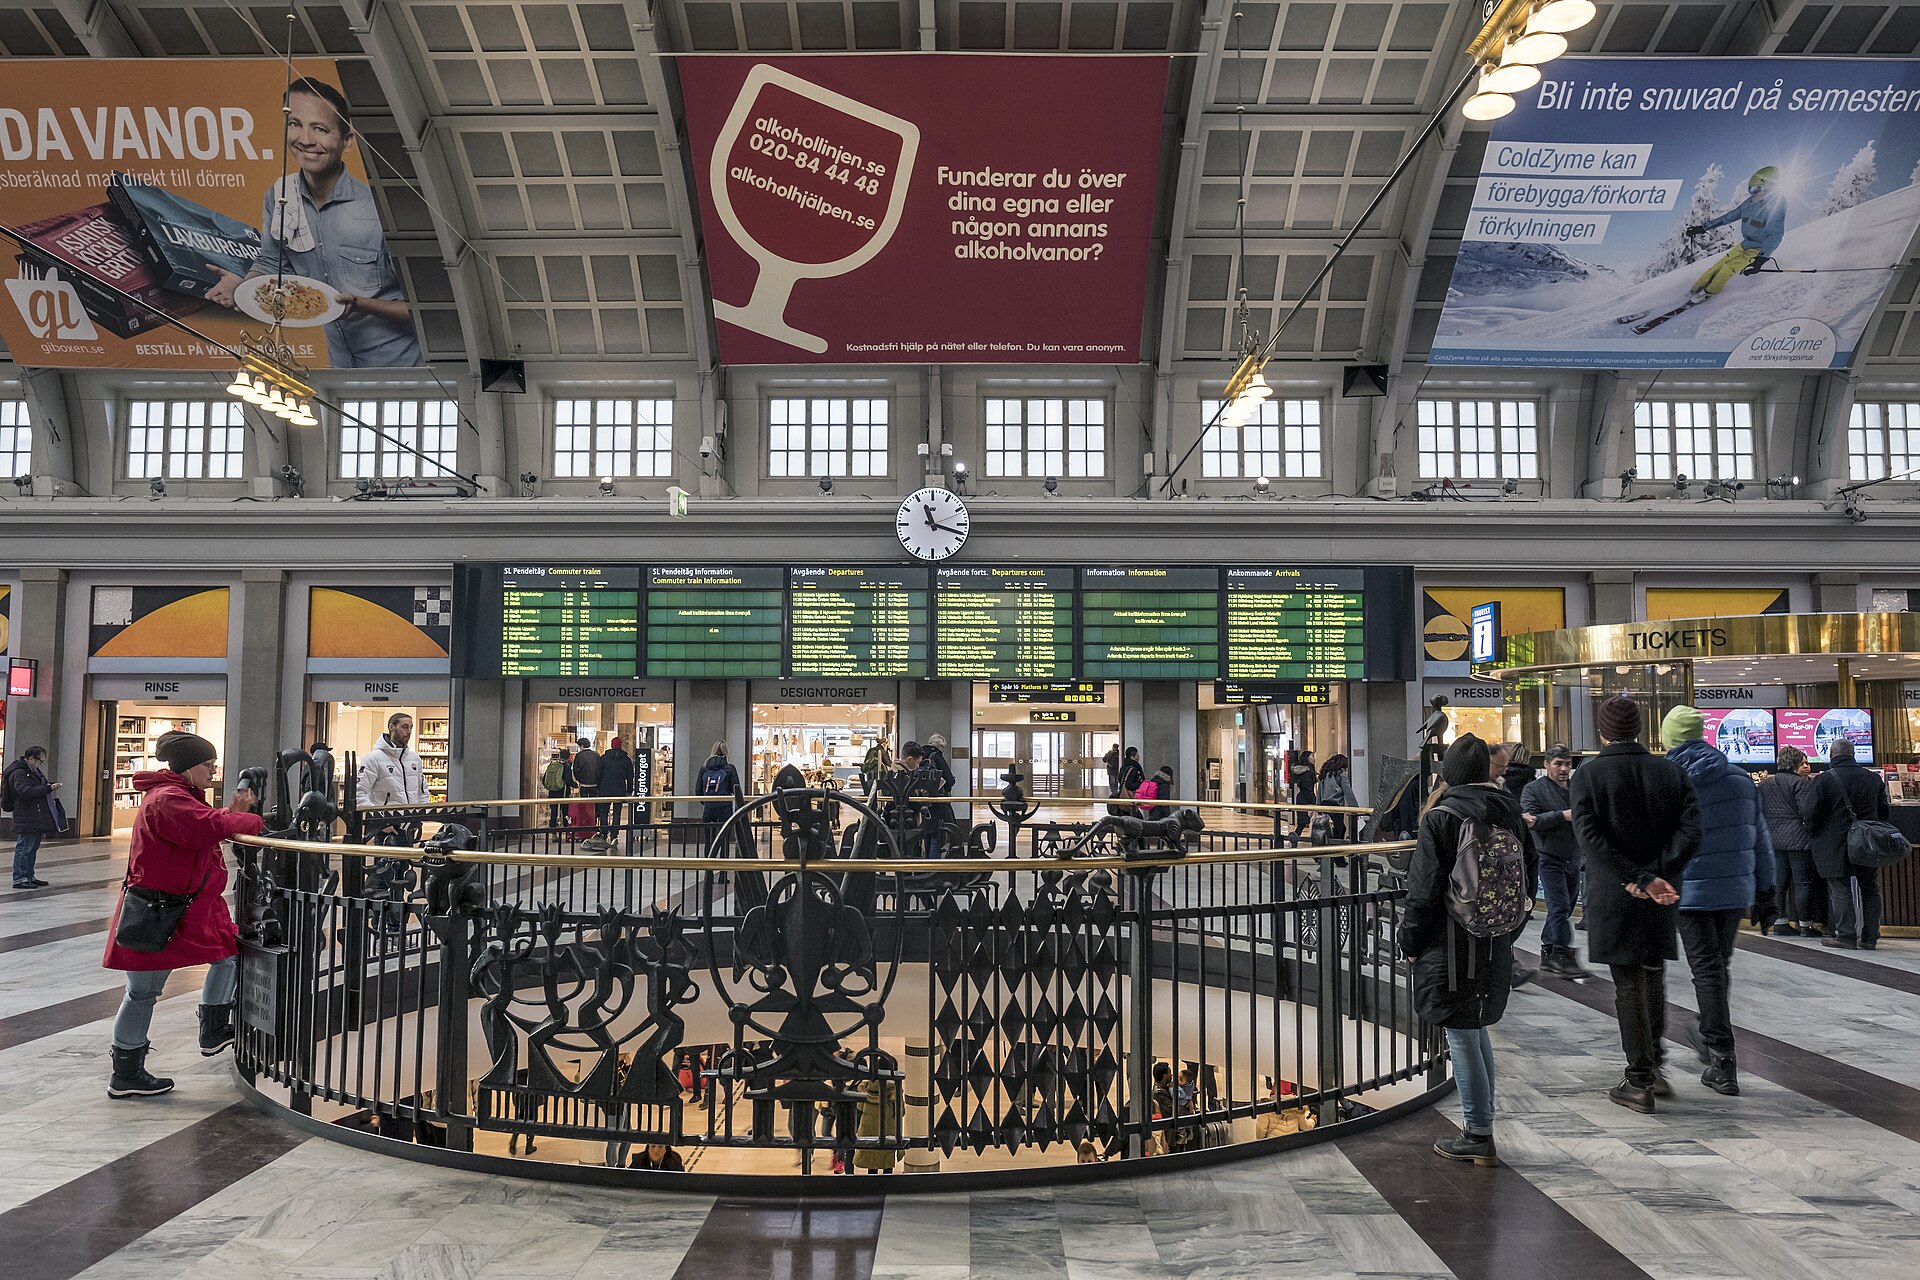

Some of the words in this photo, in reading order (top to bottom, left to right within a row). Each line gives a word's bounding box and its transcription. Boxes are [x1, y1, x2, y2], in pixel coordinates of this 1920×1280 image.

[1537, 80, 1574, 110] Bli
[1581, 81, 1633, 111] inte
[1640, 80, 1743, 112] snuvad
[1743, 78, 1785, 116] på
[0, 107, 74, 161] DA
[70, 106, 274, 161] VANOR.
[754, 116, 886, 178] alkohollinjen.se
[749, 133, 820, 174] 020-84
[824, 164, 850, 185] 44
[854, 175, 880, 196] 48
[1497, 146, 1595, 172] ColdZyme
[1600, 149, 1637, 170] kan
[0, 169, 82, 189] sberäknad
[86, 172, 119, 187] mat
[122, 169, 167, 188] direkt
[170, 168, 192, 188] till
[196, 168, 246, 188] dörren
[937, 166, 1037, 188] Funderar
[1042, 167, 1072, 188] du
[1078, 168, 1127, 189] över
[730, 166, 876, 230] alkoholhjälpen.se
[1487, 181, 1667, 209] förebygga/förkorta
[948, 190, 996, 212] dina
[1002, 198, 1060, 218] egna
[1065, 193, 1115, 213] eller
[951, 215, 1021, 241] någon
[1027, 222, 1108, 238] annans
[1477, 214, 1597, 240] förkylningen
[954, 239, 1104, 261] alkoholvanor?
[40, 342, 105, 355] giboxen.se
[135, 342, 186, 355] BESTÄLL
[188, 342, 206, 356] PÅ
[846, 342, 899, 352] Kostnadsfri
[900, 342, 924, 354] hjälp
[926, 342, 939, 353] på
[941, 342, 965, 351] nätet
[967, 342, 988, 351] eller
[989, 342, 1025, 351] telefon.
[1027, 343, 1041, 352] Du
[1043, 343, 1061, 352] kan
[1086, 345, 1126, 354] anonym.
[503, 567, 512, 575] SL
[513, 567, 546, 576] Pendeltåg
[548, 567, 581, 576] Commuter
[583, 567, 602, 576] trains
[652, 567, 661, 575] SL
[661, 567, 694, 576] Pendeltåg
[695, 567, 733, 576] Information
[792, 568, 826, 577] Avgående
[828, 568, 864, 577] Departures
[937, 568, 970, 578] Avgående
[971, 568, 989, 576] forts.
[991, 568, 1028, 578] Departures
[1086, 568, 1126, 577] Information
[1128, 568, 1167, 577] Information
[1227, 569, 1273, 577] Ankommande
[1275, 569, 1301, 577] Arrivals
[652, 576, 686, 585] Commuter
[687, 576, 703, 585] train
[703, 576, 742, 585] Information
[1627, 628, 1727, 651] TICKETS
[144, 682, 180, 693] RINSE
[364, 682, 399, 693] RINSE
[558, 687, 647, 698] DESIGNTORGET
[780, 687, 868, 698] DESIGNTORGET
[1454, 687, 1502, 699] PRESSB
